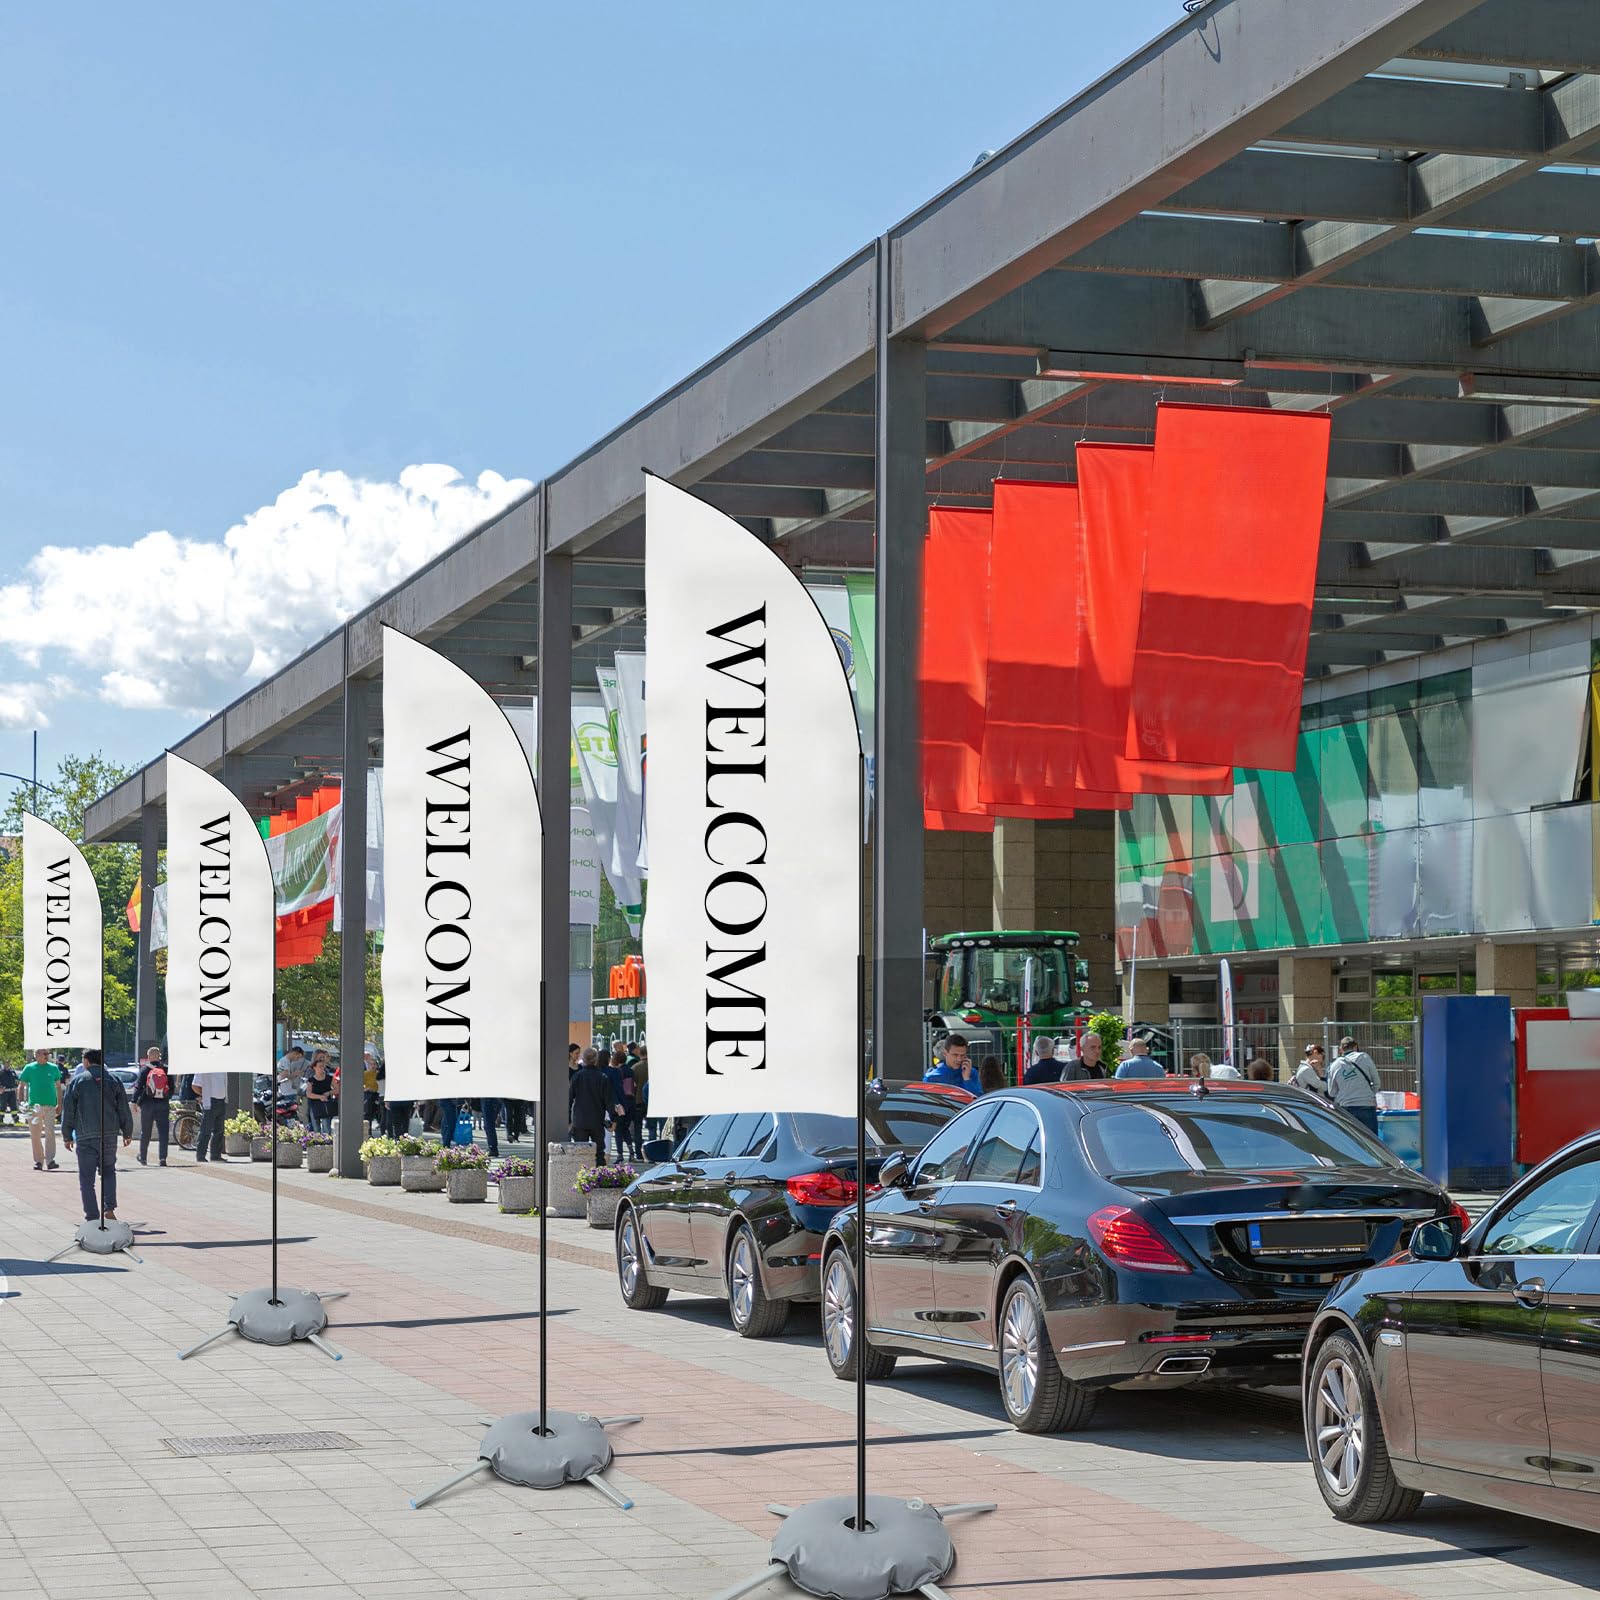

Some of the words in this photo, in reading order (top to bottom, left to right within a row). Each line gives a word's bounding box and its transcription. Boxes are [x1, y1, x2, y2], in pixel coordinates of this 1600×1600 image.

[46, 856, 71, 1037] WELCOME
[199, 812, 231, 1049] WELCOME
[425, 725, 472, 1076] WELCOME
[705, 601, 767, 1076] WELCOME
